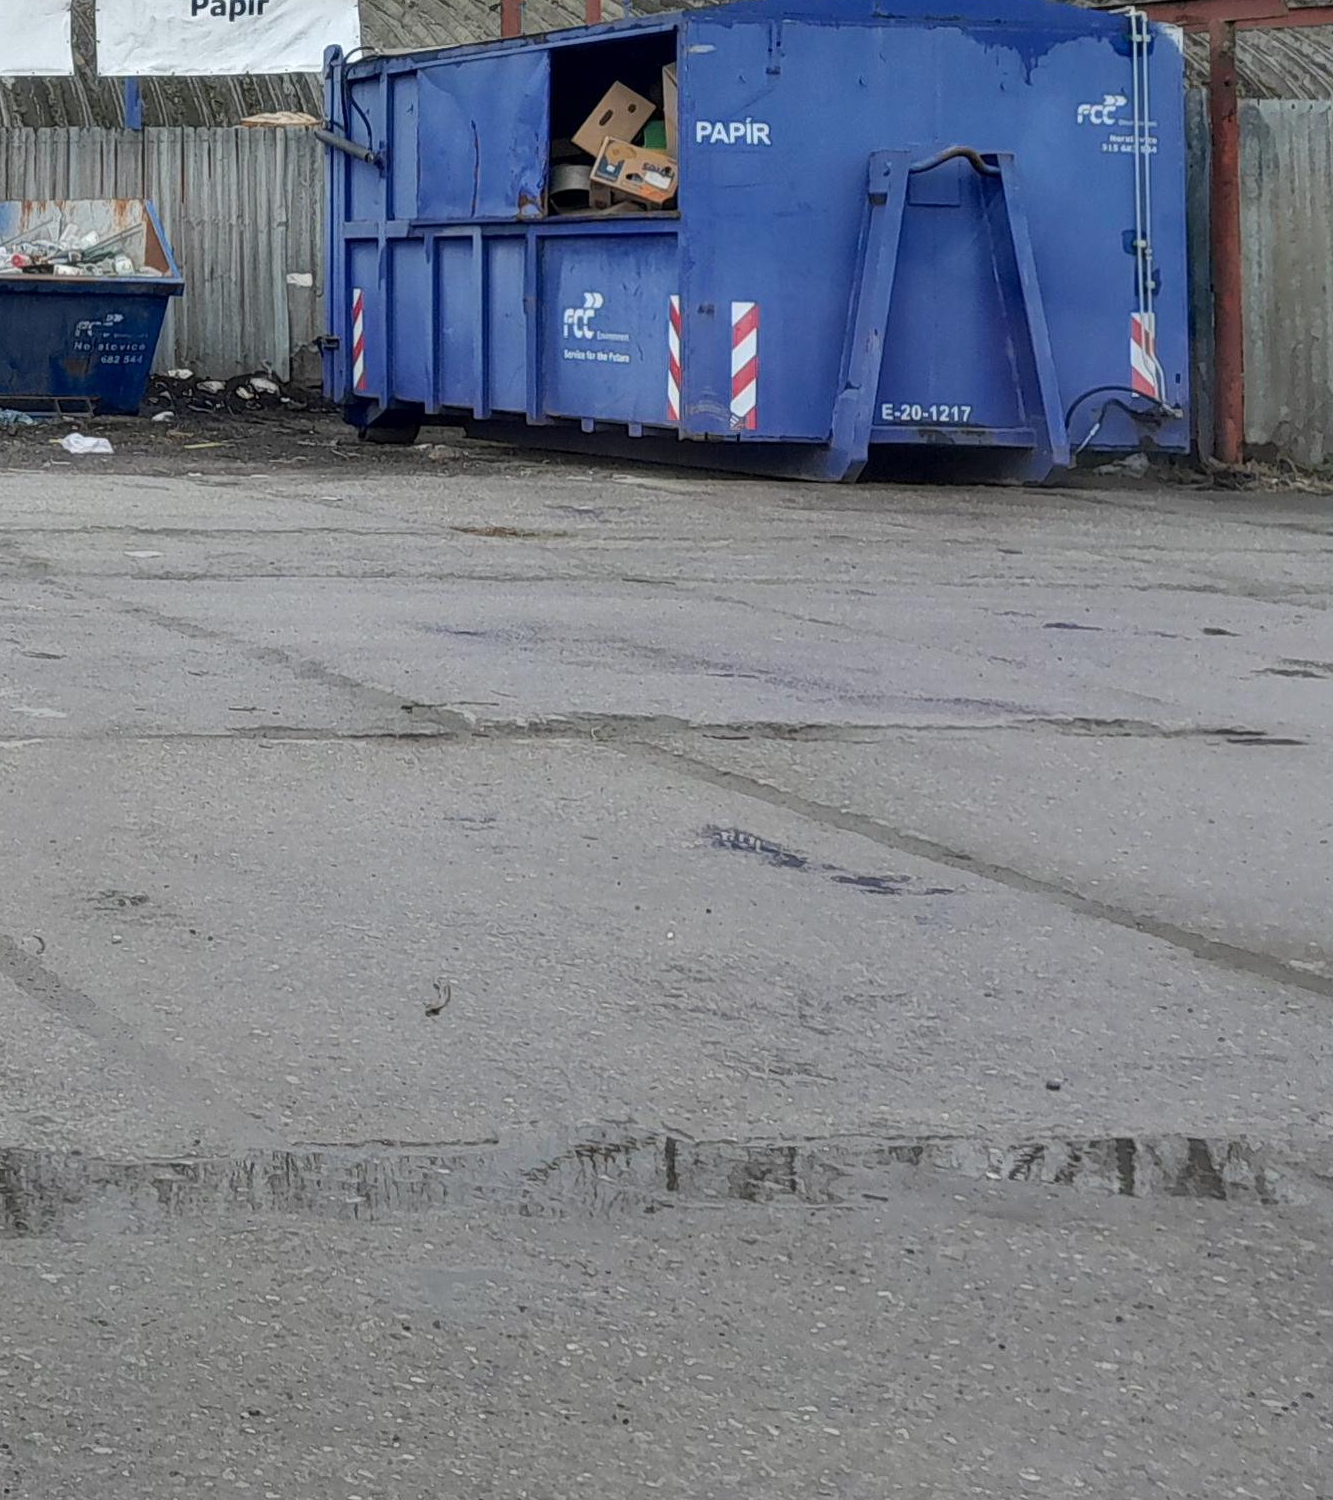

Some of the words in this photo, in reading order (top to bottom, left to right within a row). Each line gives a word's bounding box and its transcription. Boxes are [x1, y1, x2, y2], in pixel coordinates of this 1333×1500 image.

[1077, 104, 1116, 125] FCC
[695, 117, 772, 145] PAPÍR
[563, 308, 596, 339] FCC
[73, 342, 147, 352] Neatovice
[881, 403, 972, 422] E-20-1217
